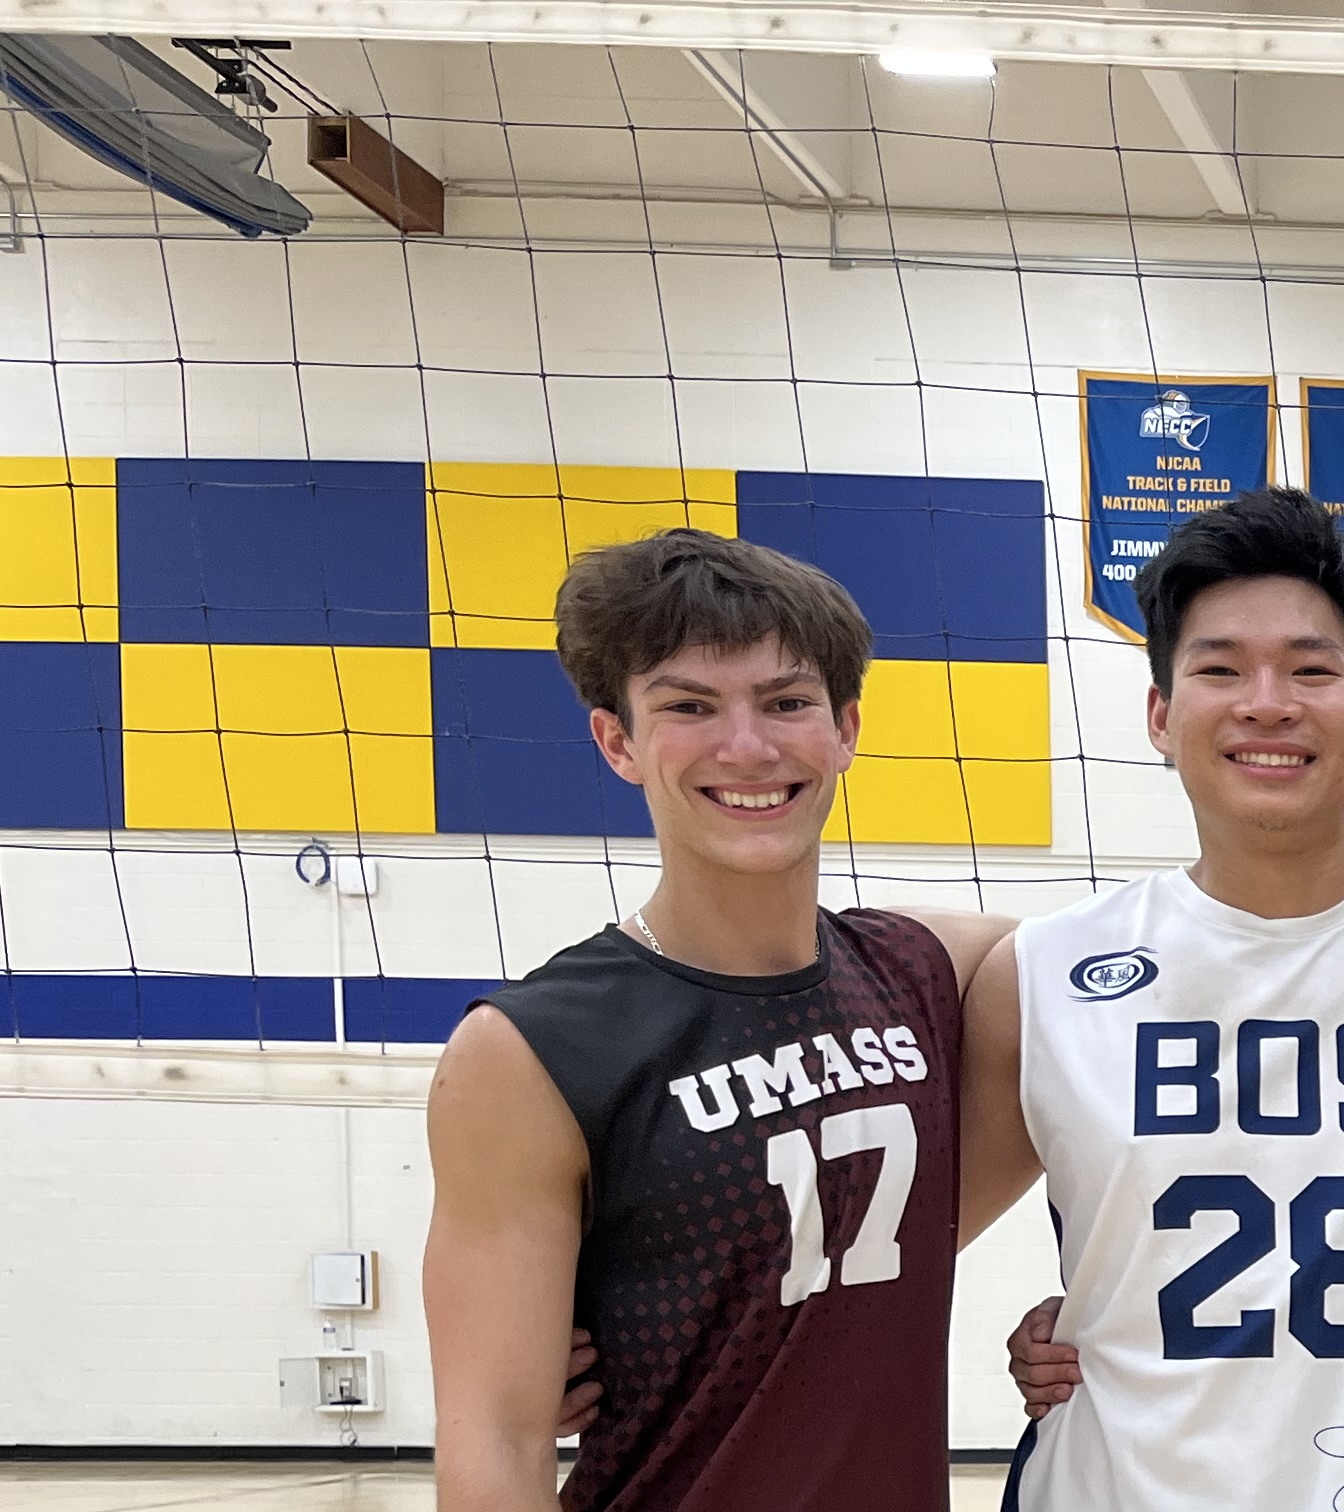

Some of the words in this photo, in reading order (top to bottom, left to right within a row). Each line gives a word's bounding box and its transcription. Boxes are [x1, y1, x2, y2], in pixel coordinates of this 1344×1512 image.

[1144, 418, 1193, 435] NECC
[1156, 456, 1201, 471] NJCAA
[1127, 476, 1174, 491] TRACK
[1177, 478, 1187, 491] &
[1191, 478, 1231, 493] FIELD
[1102, 564, 1137, 581] 400
[669, 1026, 928, 1133] UMASS
[767, 1103, 918, 1306] 17
